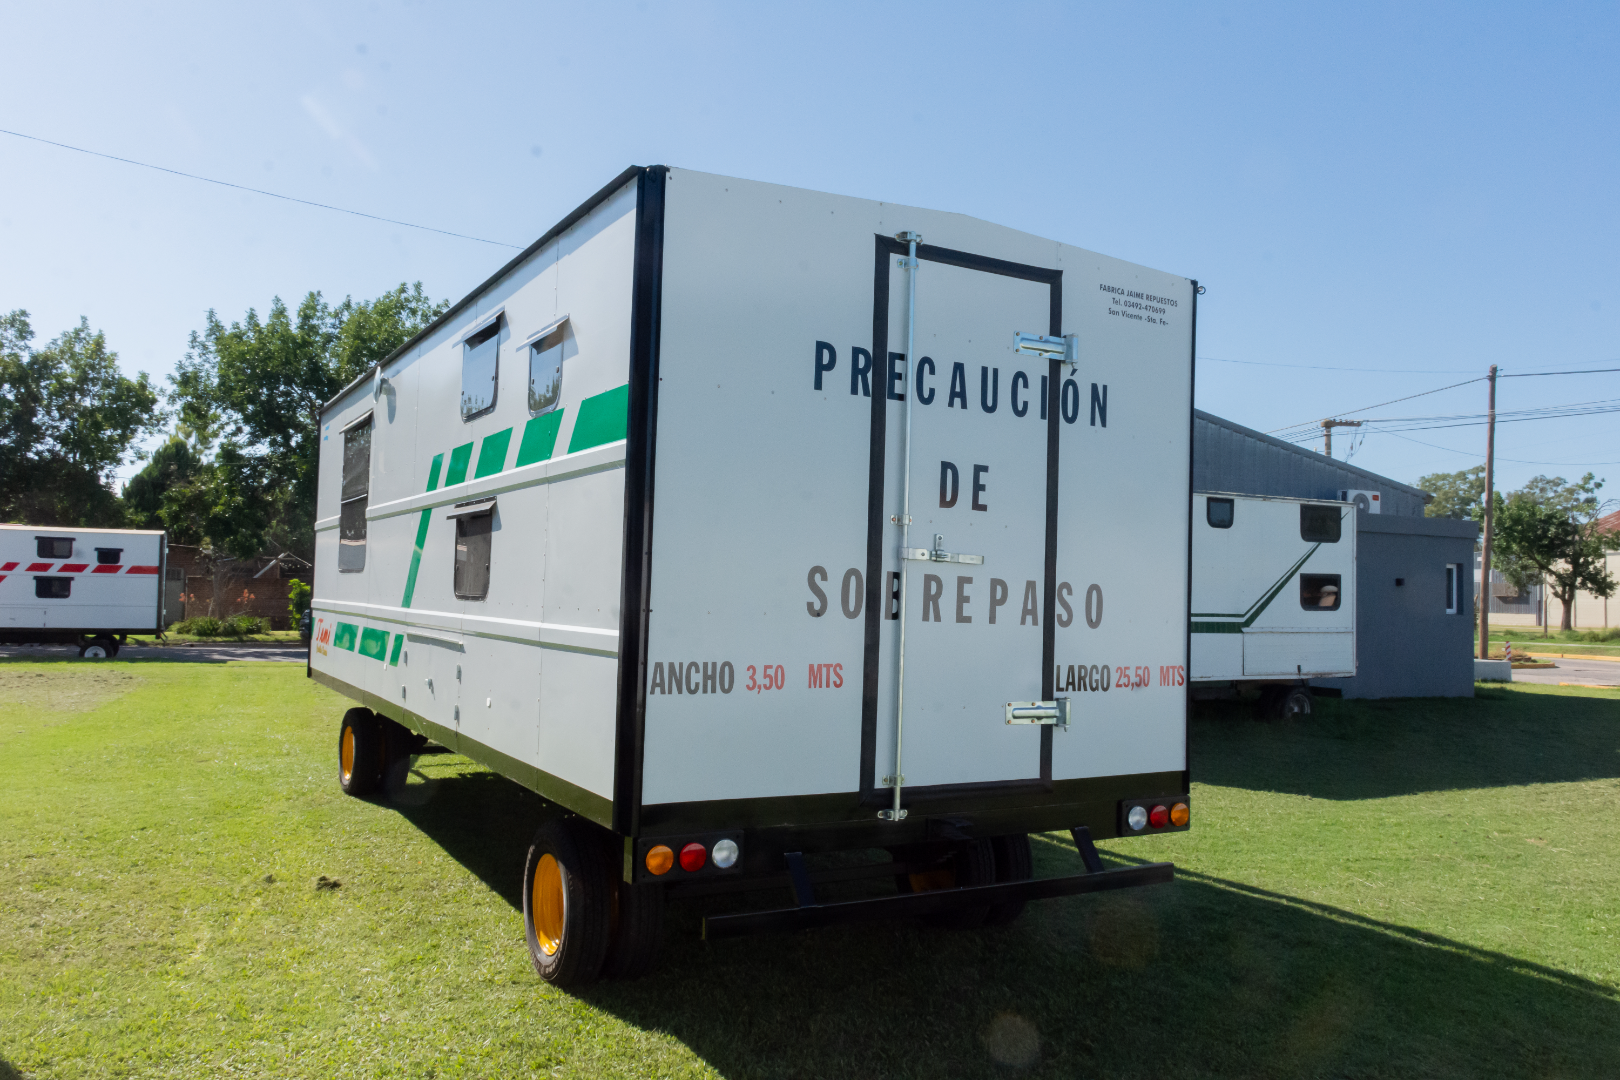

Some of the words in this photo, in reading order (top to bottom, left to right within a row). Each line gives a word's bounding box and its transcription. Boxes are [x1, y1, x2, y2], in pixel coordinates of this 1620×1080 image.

[1099, 284, 1124, 295] FABRICA
[1126, 290, 1144, 299] JAIME
[1146, 294, 1178, 307] REPUESTOS
[1112, 297, 1122, 306] Tel.
[1108, 308, 1120, 316] San
[1121, 310, 1142, 320] Vicente
[813, 339, 1108, 428] PRECAUCIÓN
[939, 460, 989, 512] DE
[806, 565, 1104, 630] SOBREPASO
[650, 660, 735, 695] ANCHO
[745, 664, 785, 695] 3,50
[807, 662, 844, 689] MTS
[1055, 664, 1111, 692] LARGO
[1115, 665, 1151, 691] 25,50
[1159, 664, 1185, 687] MTS
